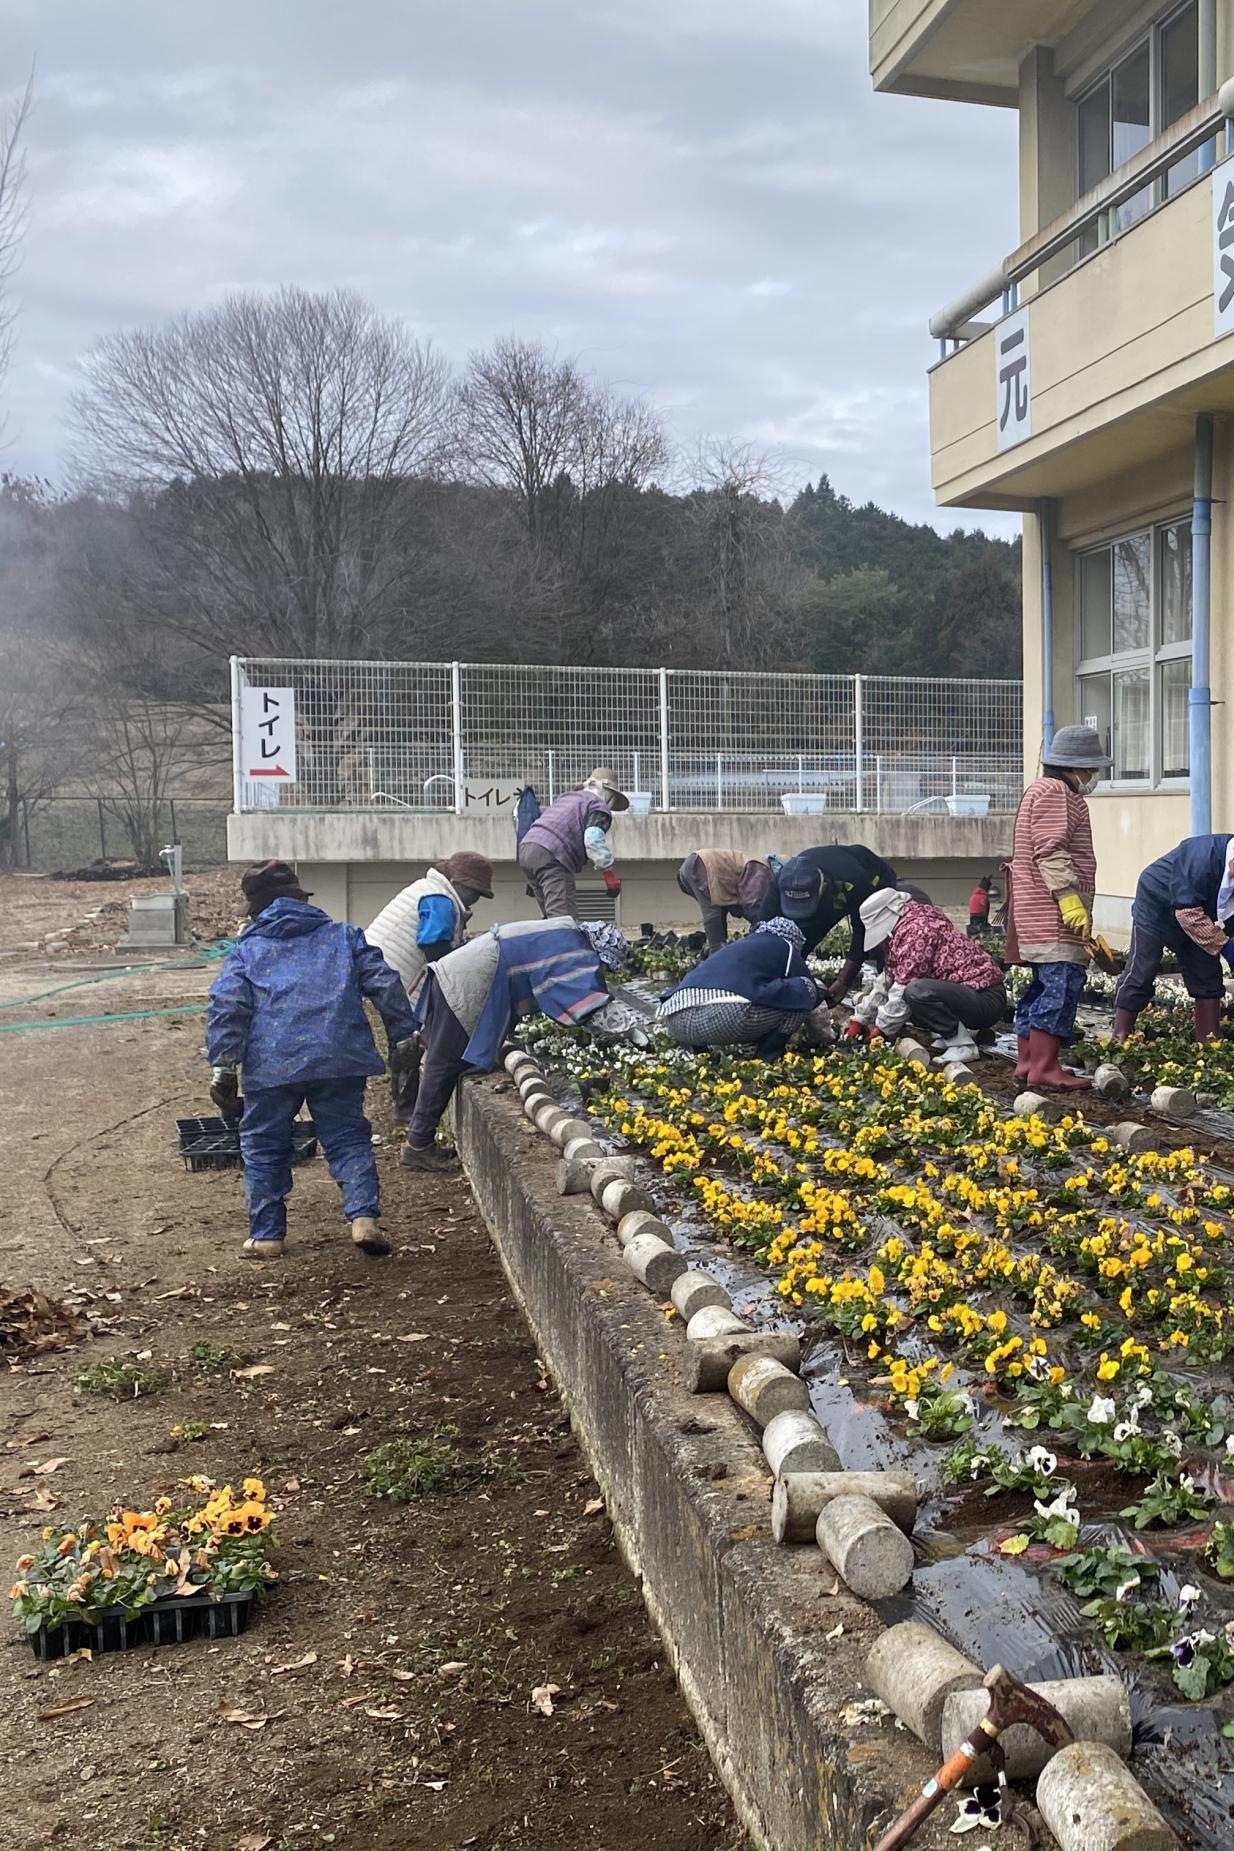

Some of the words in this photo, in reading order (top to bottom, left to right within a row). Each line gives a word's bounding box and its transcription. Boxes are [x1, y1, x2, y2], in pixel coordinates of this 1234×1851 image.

[999, 327, 1028, 433] 元
[258, 692, 281, 758] トイレ
[465, 786, 511, 807] トイレ
